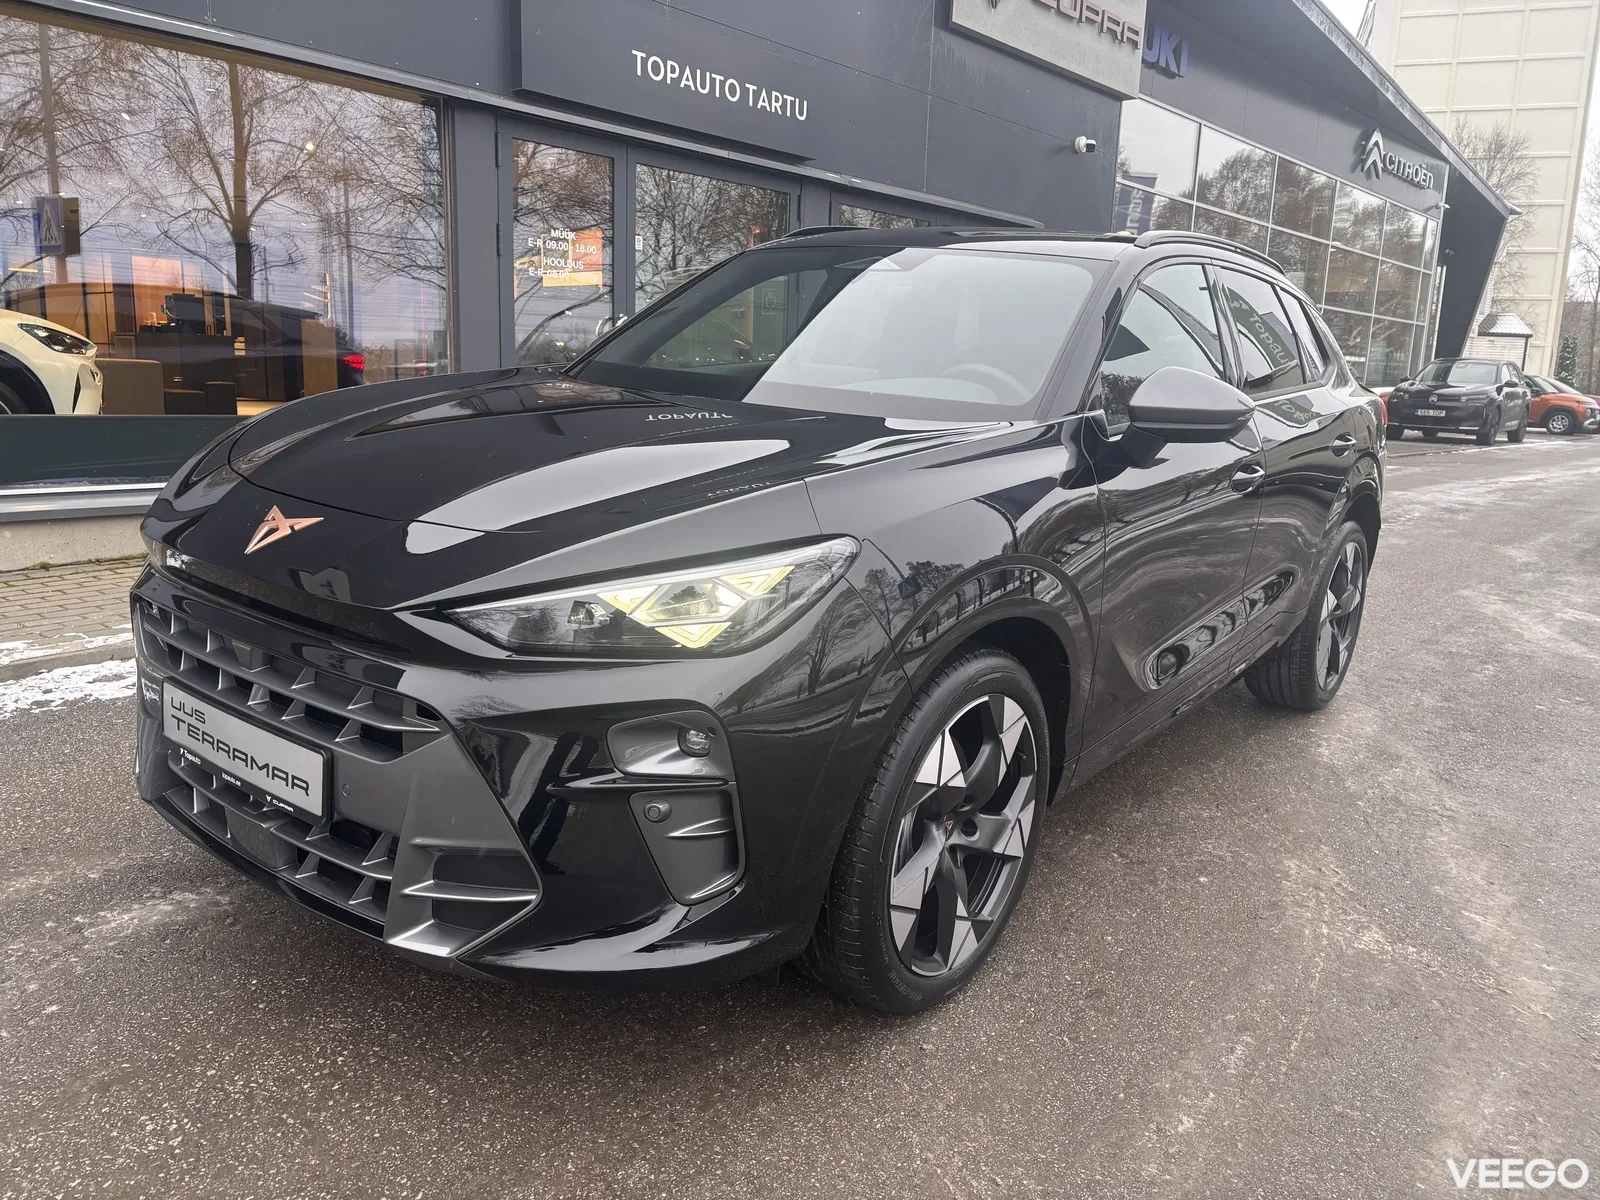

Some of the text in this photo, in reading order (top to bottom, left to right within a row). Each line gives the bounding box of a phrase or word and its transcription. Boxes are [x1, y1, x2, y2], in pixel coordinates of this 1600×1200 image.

[1032, 0, 1142, 50] UPRA
[631, 49, 808, 121] TOPAUTO TARTU
[550, 228, 576, 240] MÜÜK
[527, 237, 542, 247] E-R
[545, 240, 569, 250] 09.00
[575, 243, 597, 254] 18.00
[543, 257, 585, 269] HOOLDUS
[528, 267, 543, 277] E-R
[1249, 313, 1289, 363] Topau
[170, 696, 206, 725] UUS
[170, 713, 310, 797] TERRAMAR
[184, 749, 202, 766] Topauto
[221, 771, 242, 787] topauto.ee
[272, 798, 294, 813] CUPRA
